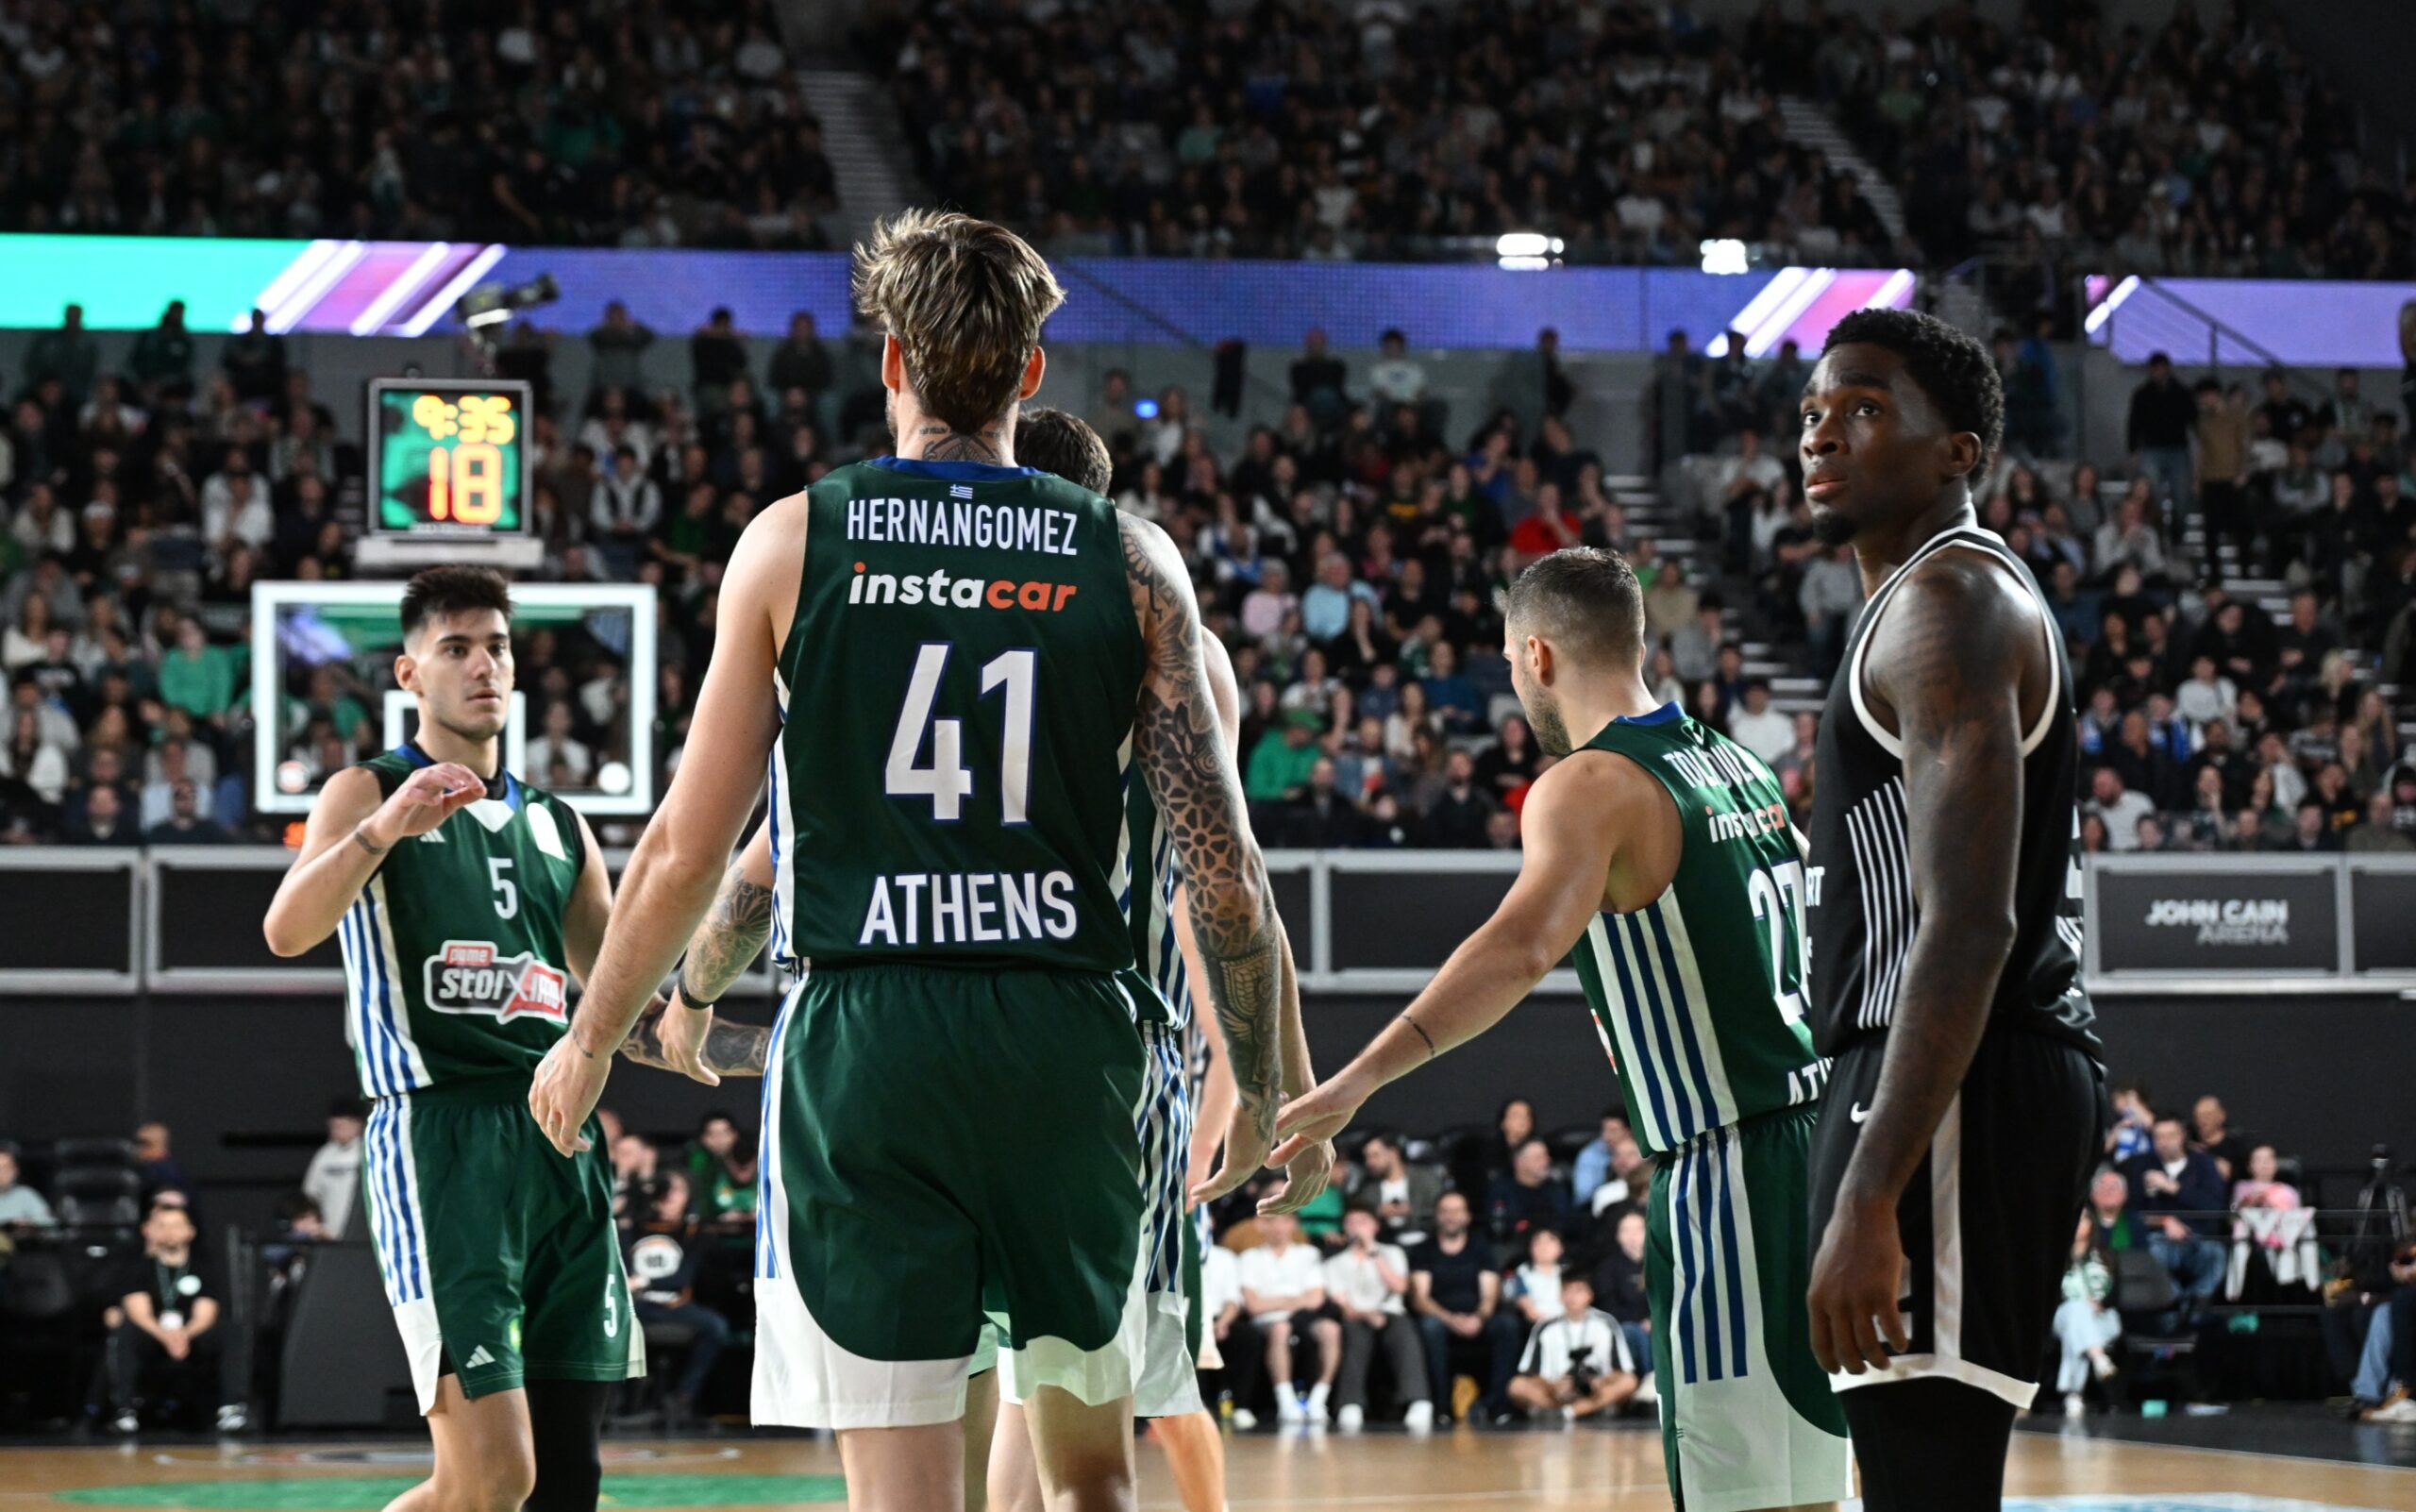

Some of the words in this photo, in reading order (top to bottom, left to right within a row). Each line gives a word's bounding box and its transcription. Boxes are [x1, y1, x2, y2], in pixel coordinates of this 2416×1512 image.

[412, 395, 515, 445] 9:35
[429, 444, 502, 525] 18
[847, 498, 1078, 556] HERNANGOMEZ
[848, 562, 1078, 612] instacar
[885, 642, 1036, 825] 41
[487, 856, 518, 920] 5
[859, 870, 1078, 946] ATHENS
[2144, 899, 2219, 926] JOHN
[2223, 899, 2289, 926] CAIN
[1748, 859, 1811, 1026] 27
[603, 1273, 618, 1337] 5
